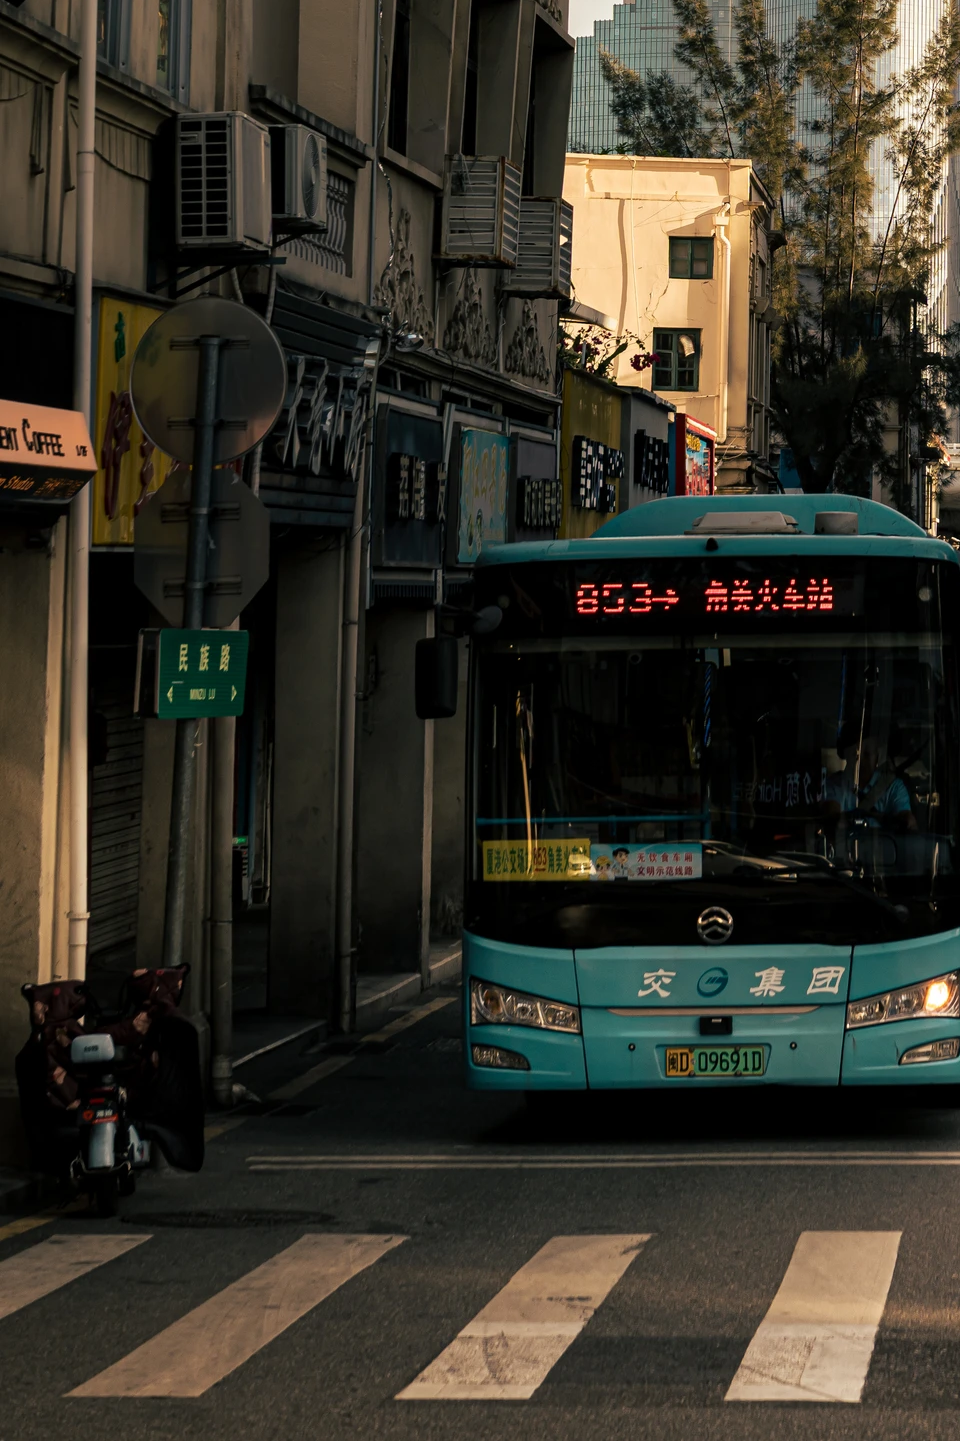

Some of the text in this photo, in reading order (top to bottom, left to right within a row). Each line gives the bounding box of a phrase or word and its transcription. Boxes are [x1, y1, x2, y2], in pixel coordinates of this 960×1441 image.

[22, 418, 66, 457] COFFEE
[3, 475, 35, 492] Studio
[178, 643, 232, 673] 民族路
[636, 865, 694, 877] 文明示范线路
[637, 965, 846, 998] 交 集团
[697, 1050, 762, 1073] 09691D
